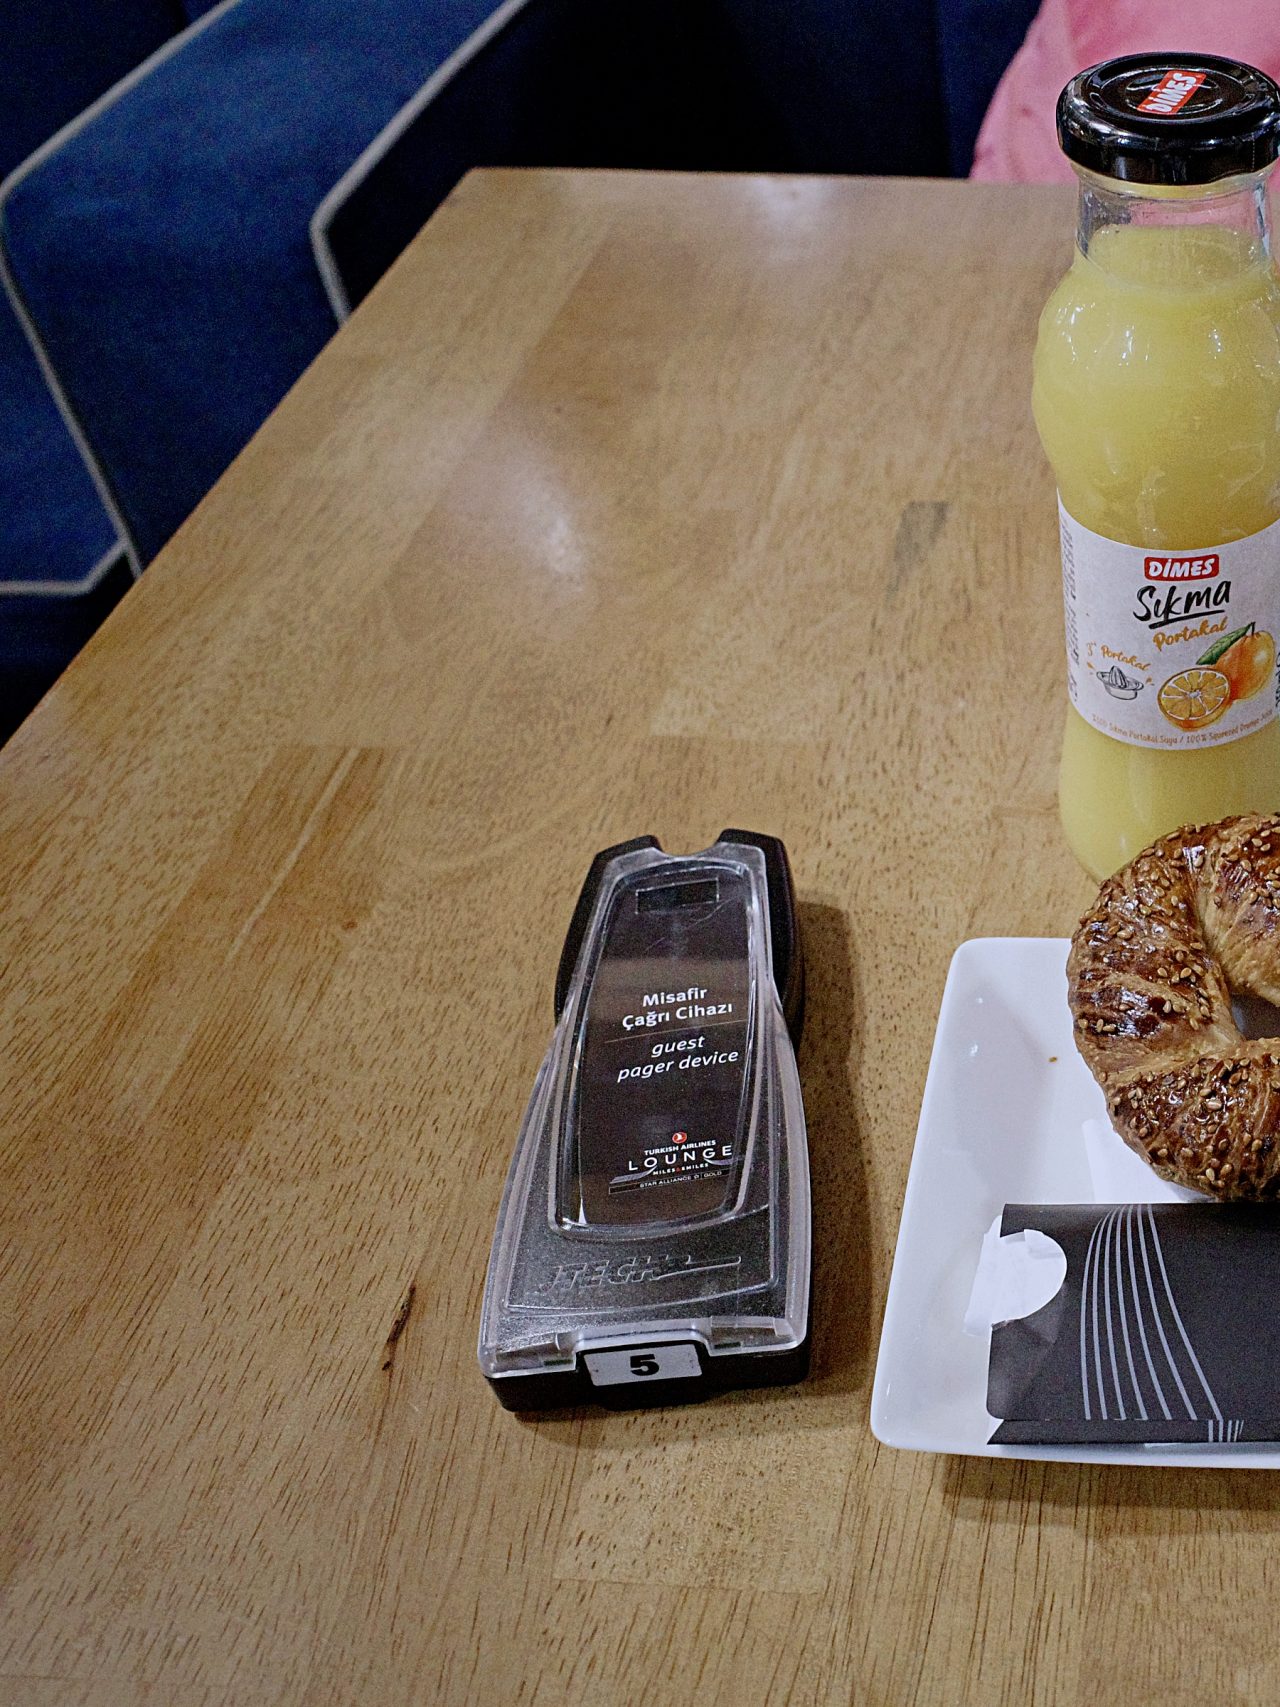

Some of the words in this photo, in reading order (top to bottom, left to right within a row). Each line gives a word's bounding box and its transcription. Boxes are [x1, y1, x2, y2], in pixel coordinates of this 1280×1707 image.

[1153, 616, 1228, 651] Portakal
[1101, 644, 1151, 671] Portakal
[642, 987, 708, 1008] Misafir
[622, 1010, 670, 1031] Çağrı
[675, 1003, 733, 1020] Cihazı
[651, 1035, 705, 1058] guest
[617, 1060, 675, 1083] pager
[678, 1051, 739, 1070] device
[628, 1145, 732, 1171] LOUNGE
[644, 1144, 679, 1156] TURKISH
[680, 1139, 717, 1150] AIRLINES
[640, 1180, 657, 1188] STAR
[658, 1174, 692, 1185] ALLIANCE
[703, 1170, 722, 1178] GOLD
[629, 1353, 660, 1377] 5
